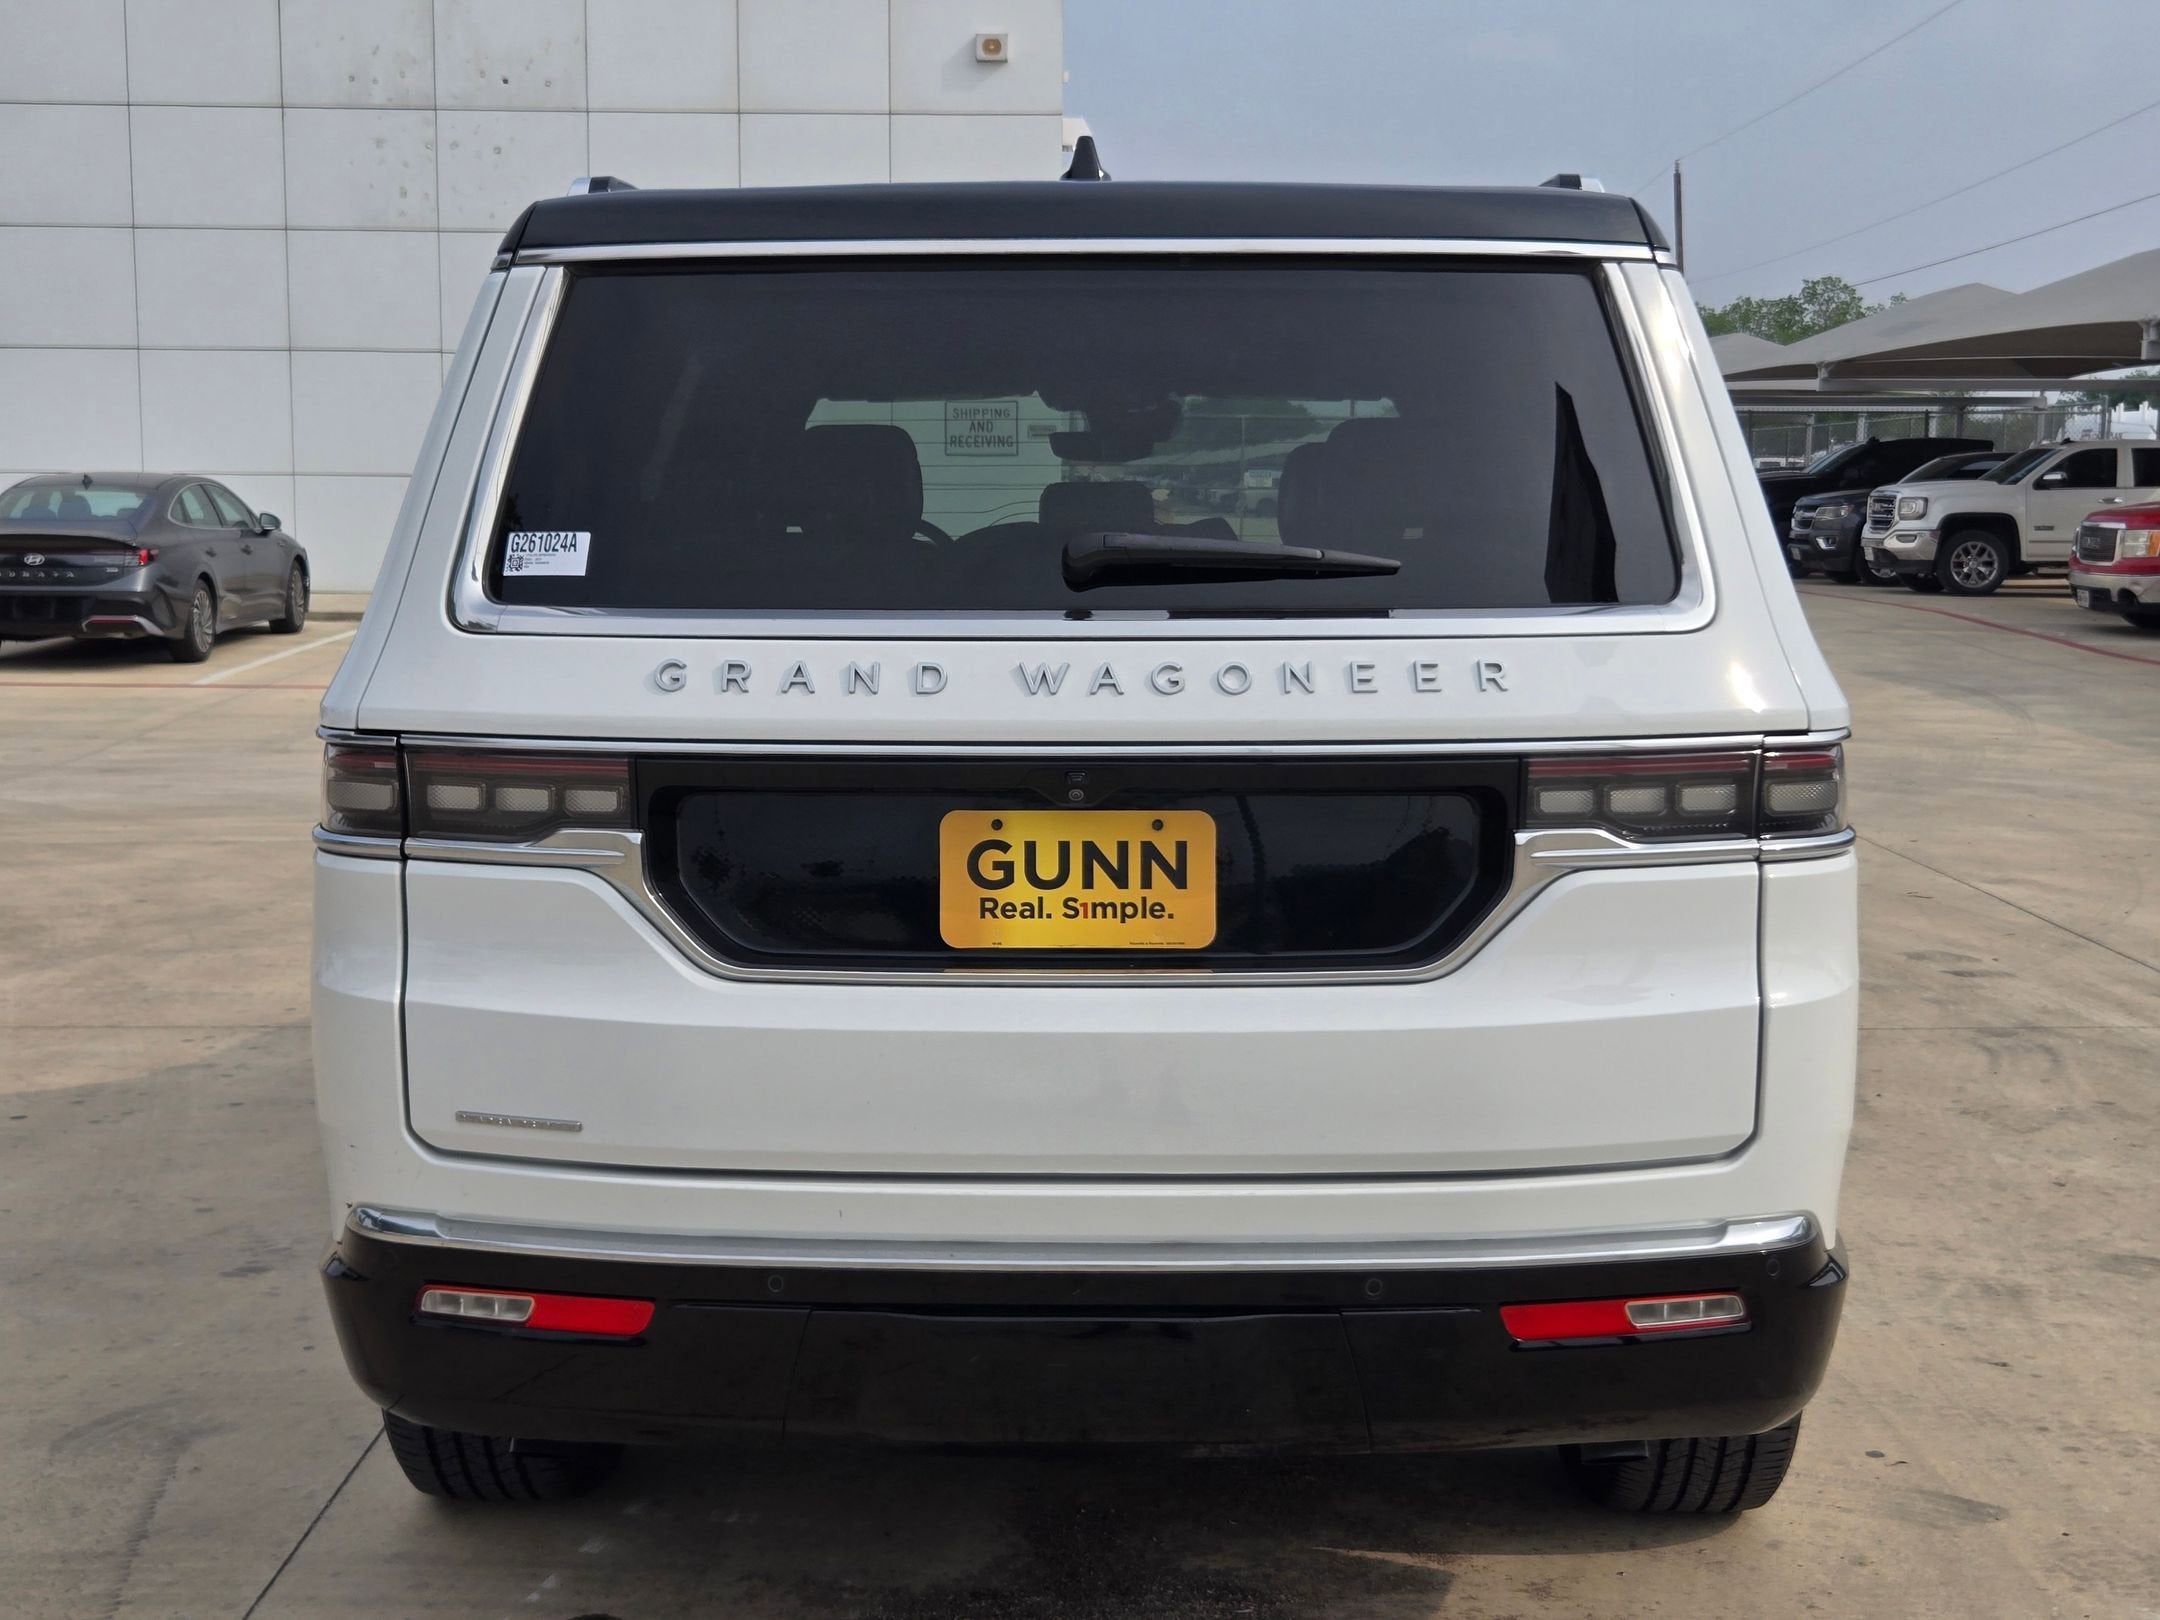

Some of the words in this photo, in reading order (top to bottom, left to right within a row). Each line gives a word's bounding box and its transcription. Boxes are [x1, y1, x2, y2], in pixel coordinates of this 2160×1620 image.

[952, 408, 1011, 419] SHIPPING
[969, 421, 994, 433] AND
[950, 435, 1014, 448] RECEIVING
[511, 533, 577, 552] G261024A
[652, 658, 948, 695] GRAND
[1017, 660, 1508, 695] WAGONEER
[967, 839, 1188, 890] GUNN
[979, 896, 1052, 920] Real.
